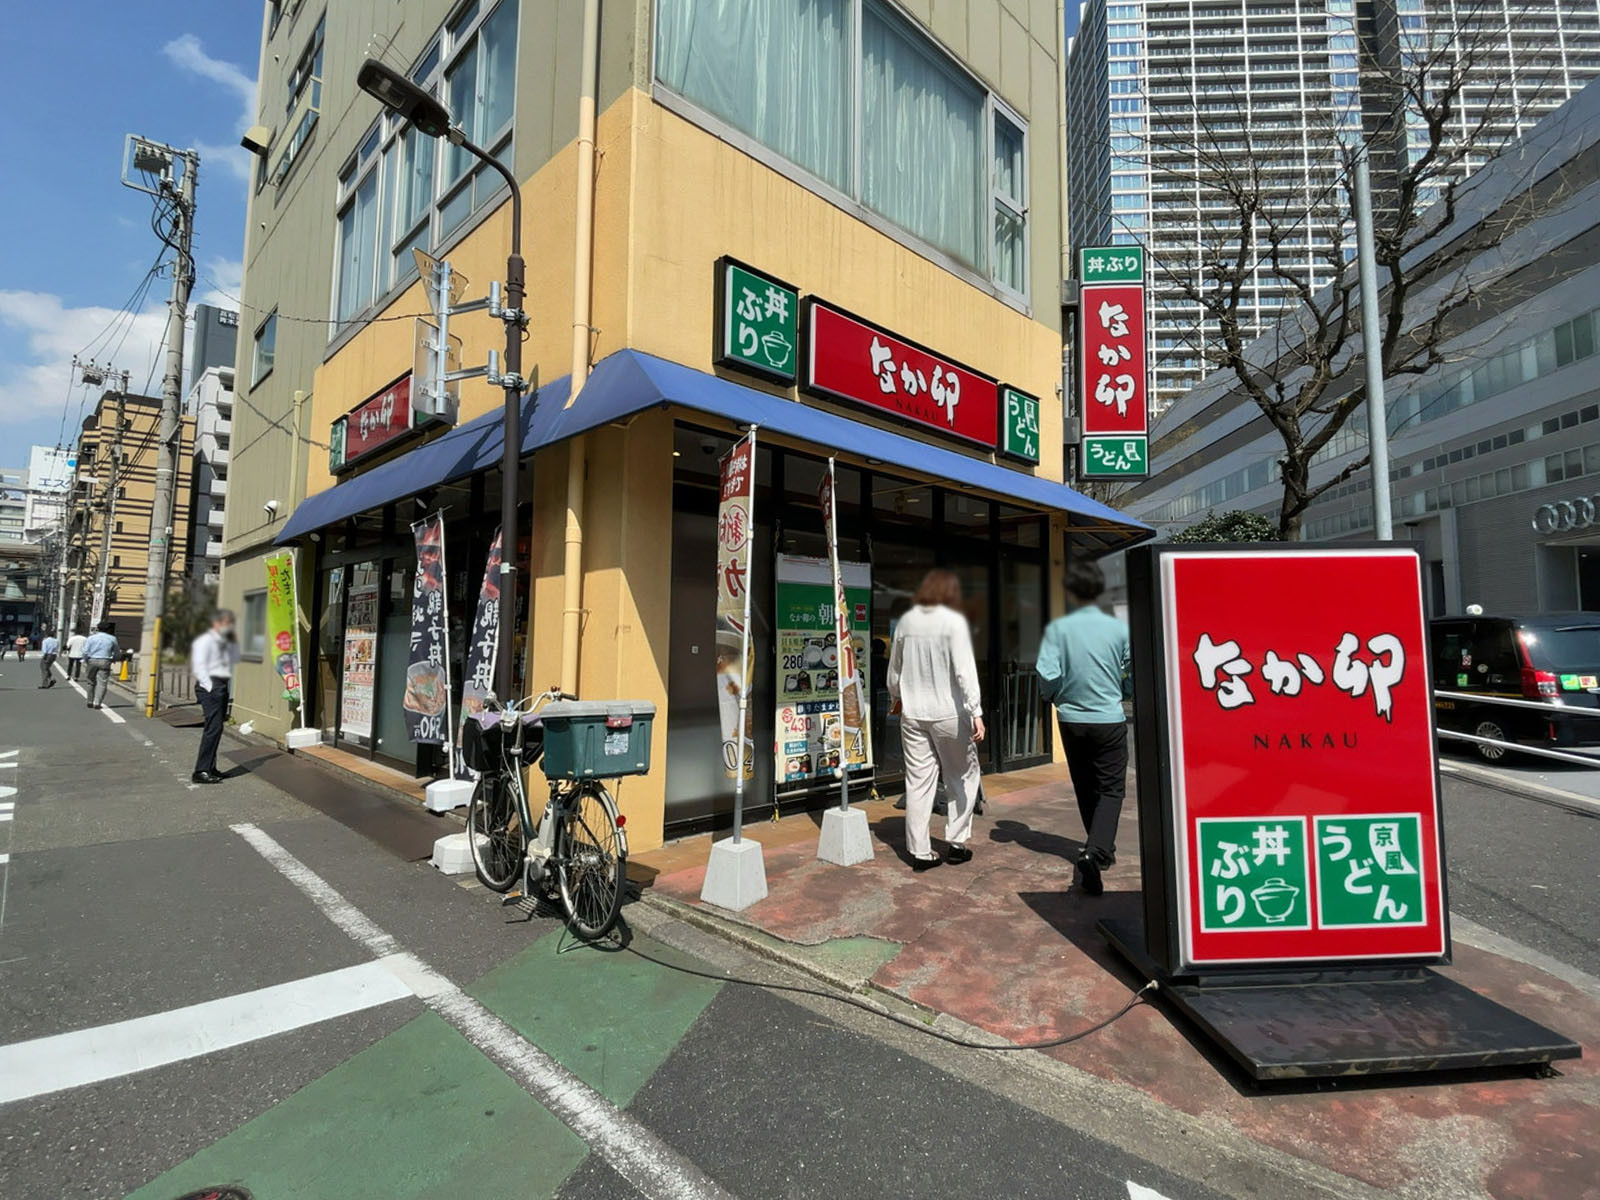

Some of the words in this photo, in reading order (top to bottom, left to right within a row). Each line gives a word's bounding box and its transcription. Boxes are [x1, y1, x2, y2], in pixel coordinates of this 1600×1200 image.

[1088, 256, 1138, 273] 丼ぶり
[870, 335, 961, 427] なか卯
[1094, 300, 1136, 418] なか卯
[1010, 394, 1036, 457] うどん
[1090, 443, 1131, 470] うどん
[1192, 632, 1406, 723] なか卯
[1253, 732, 1359, 749] NAKAU
[1210, 825, 1291, 924] 丼ぶり
[1322, 825, 1408, 921] うどん
[1373, 825, 1404, 872] 京風
